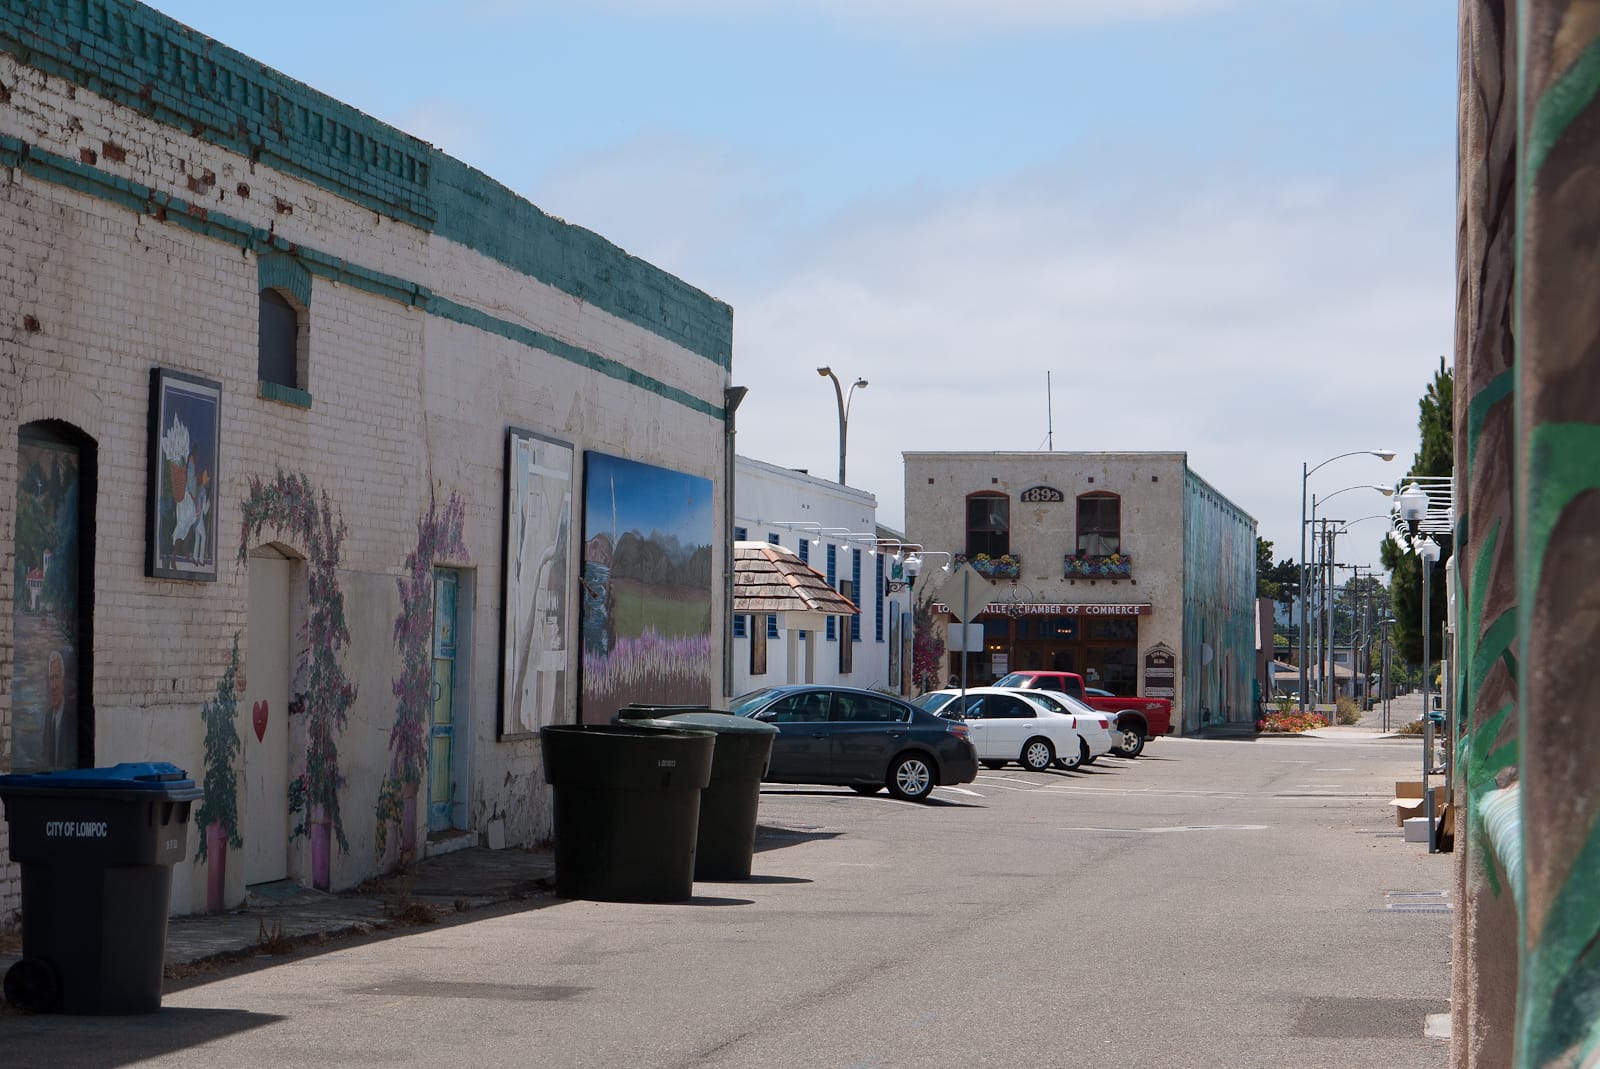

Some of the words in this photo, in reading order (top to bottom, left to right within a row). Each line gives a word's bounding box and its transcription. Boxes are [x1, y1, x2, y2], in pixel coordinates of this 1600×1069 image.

[1023, 488, 1060, 501] 1892
[1018, 605, 1061, 614] CHAMBER
[1066, 606, 1079, 614] OF
[1086, 606, 1140, 615] COMMERCE
[46, 821, 64, 837] CITY
[64, 821, 75, 837] OF
[76, 822, 107, 837] LOMPOC
